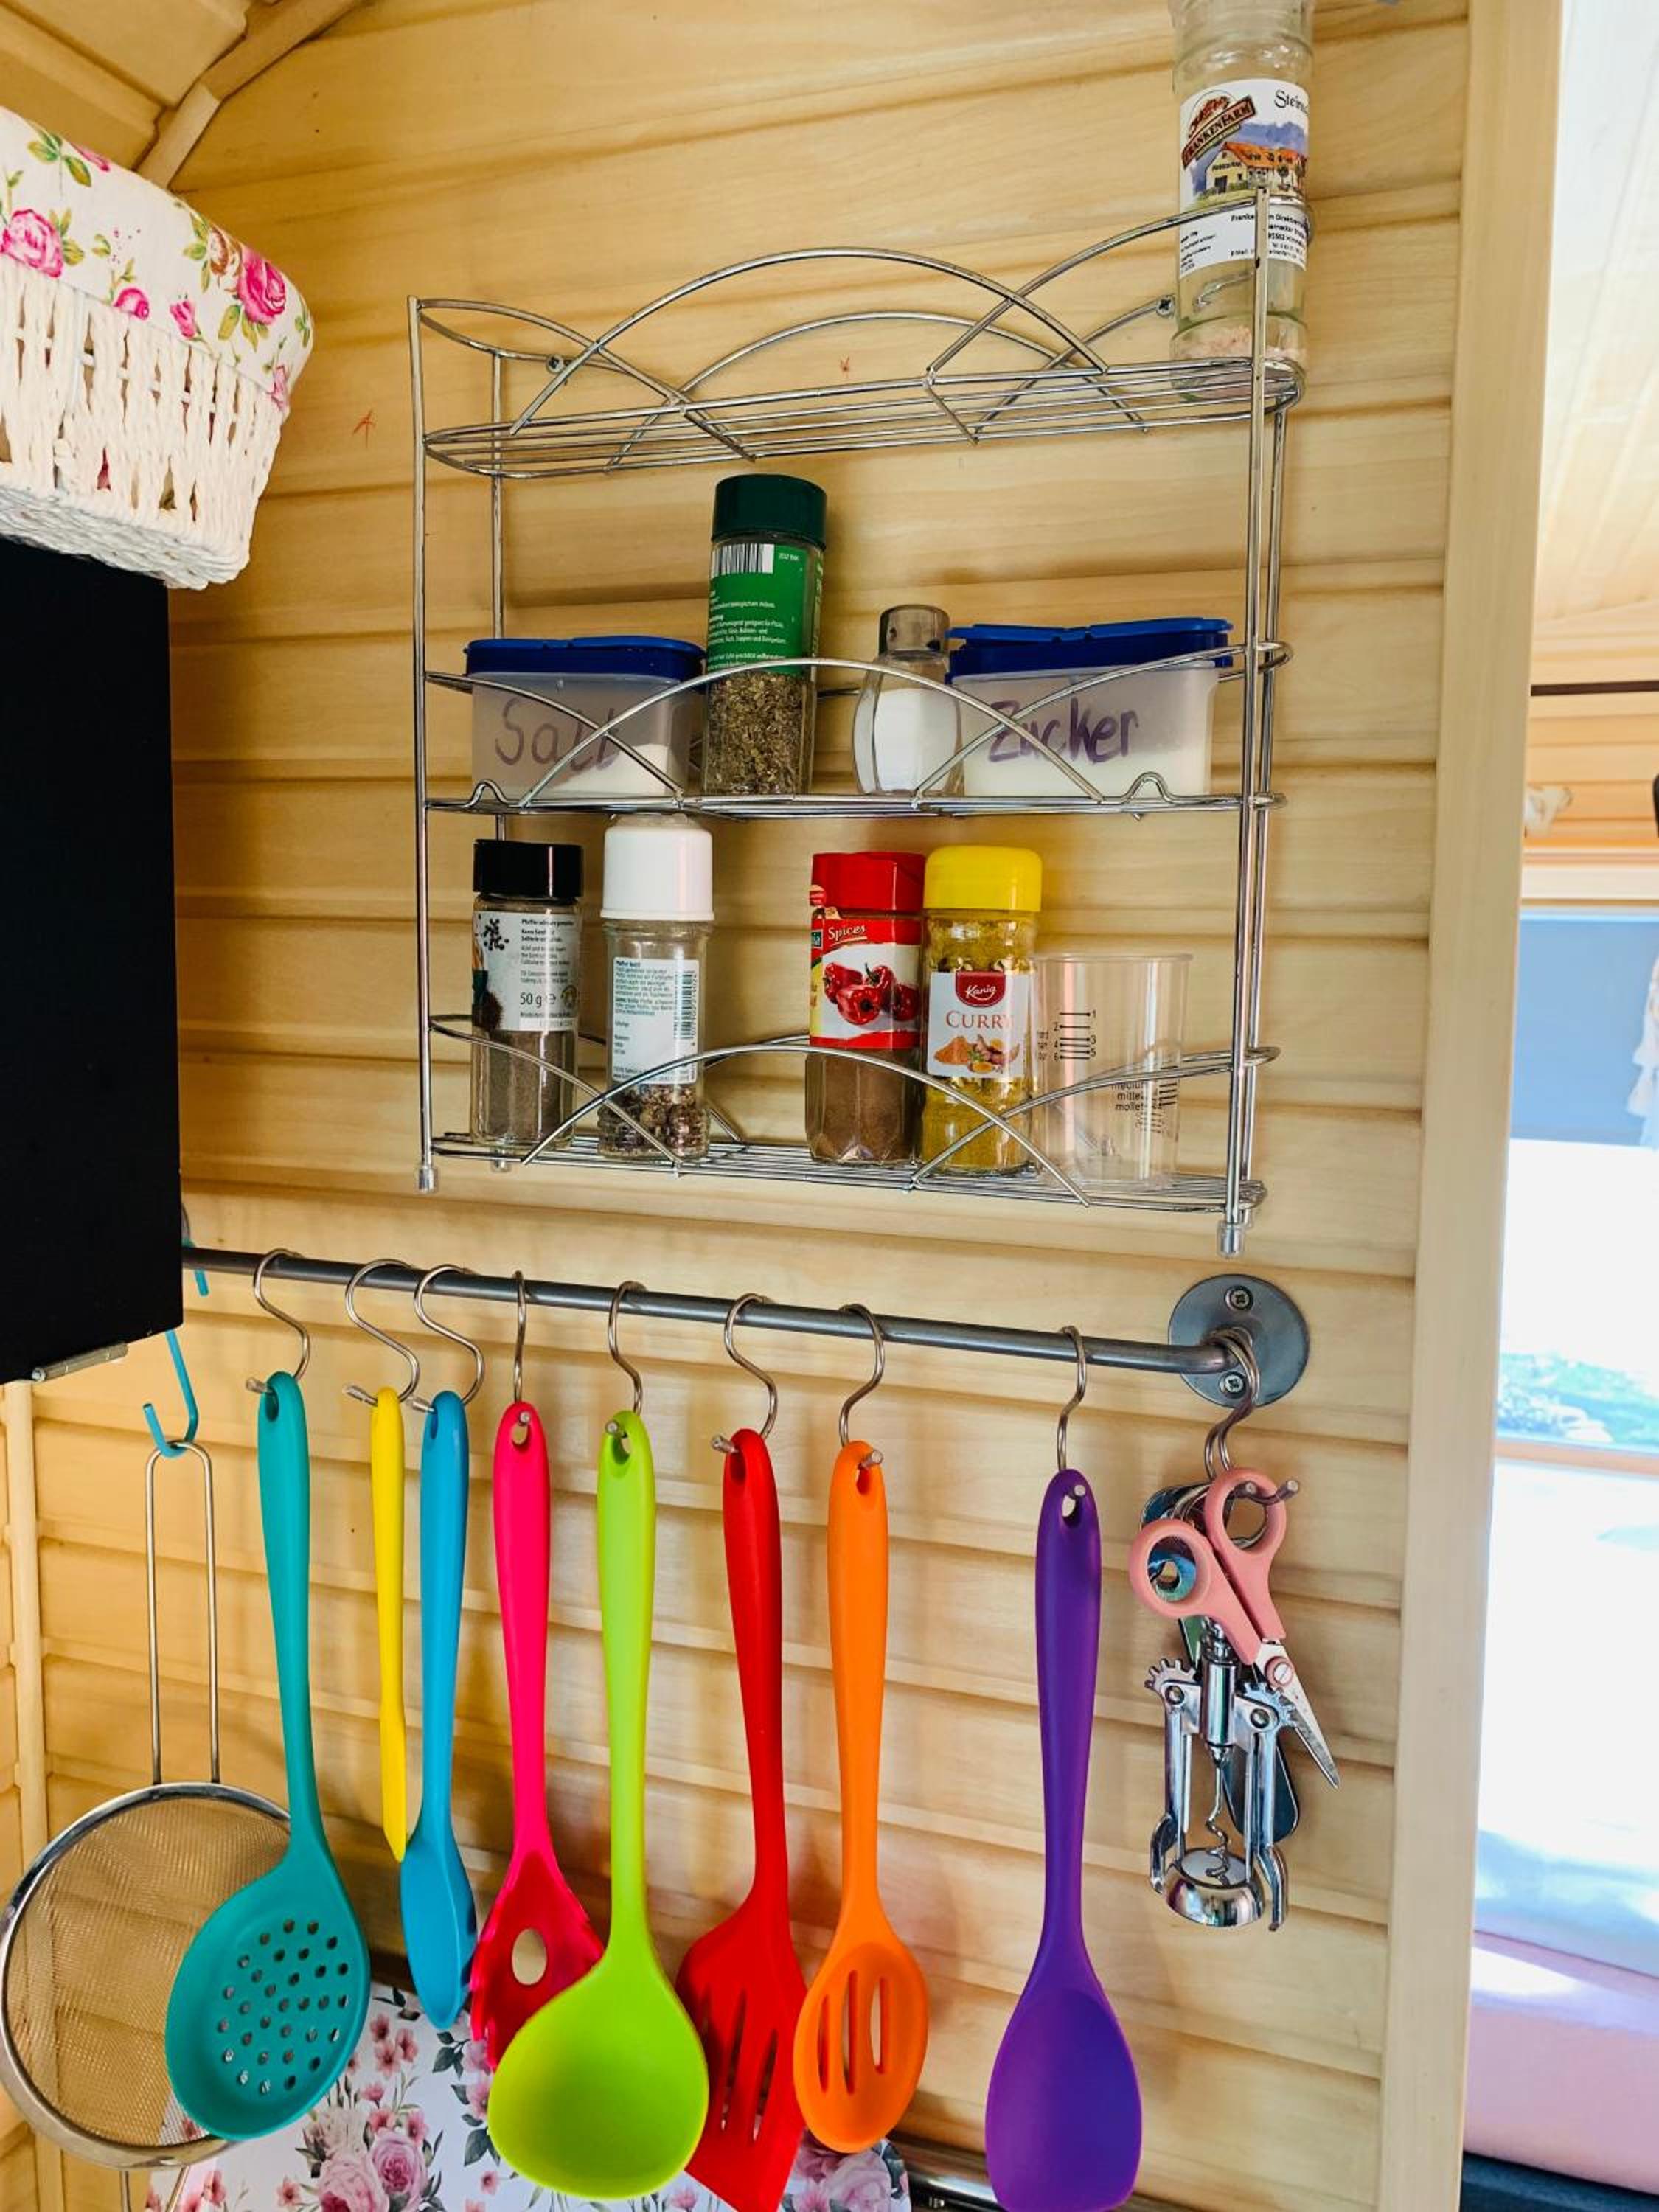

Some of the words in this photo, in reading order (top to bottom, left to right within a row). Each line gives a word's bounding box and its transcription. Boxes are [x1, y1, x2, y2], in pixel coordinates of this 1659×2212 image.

[989, 697, 1140, 764] Zucker
[828, 925, 866, 942] Spices
[965, 984, 997, 999] Kania
[520, 992, 533, 1005] 50
[536, 995, 542, 1009] g
[1091, 1034, 1096, 1045] 3
